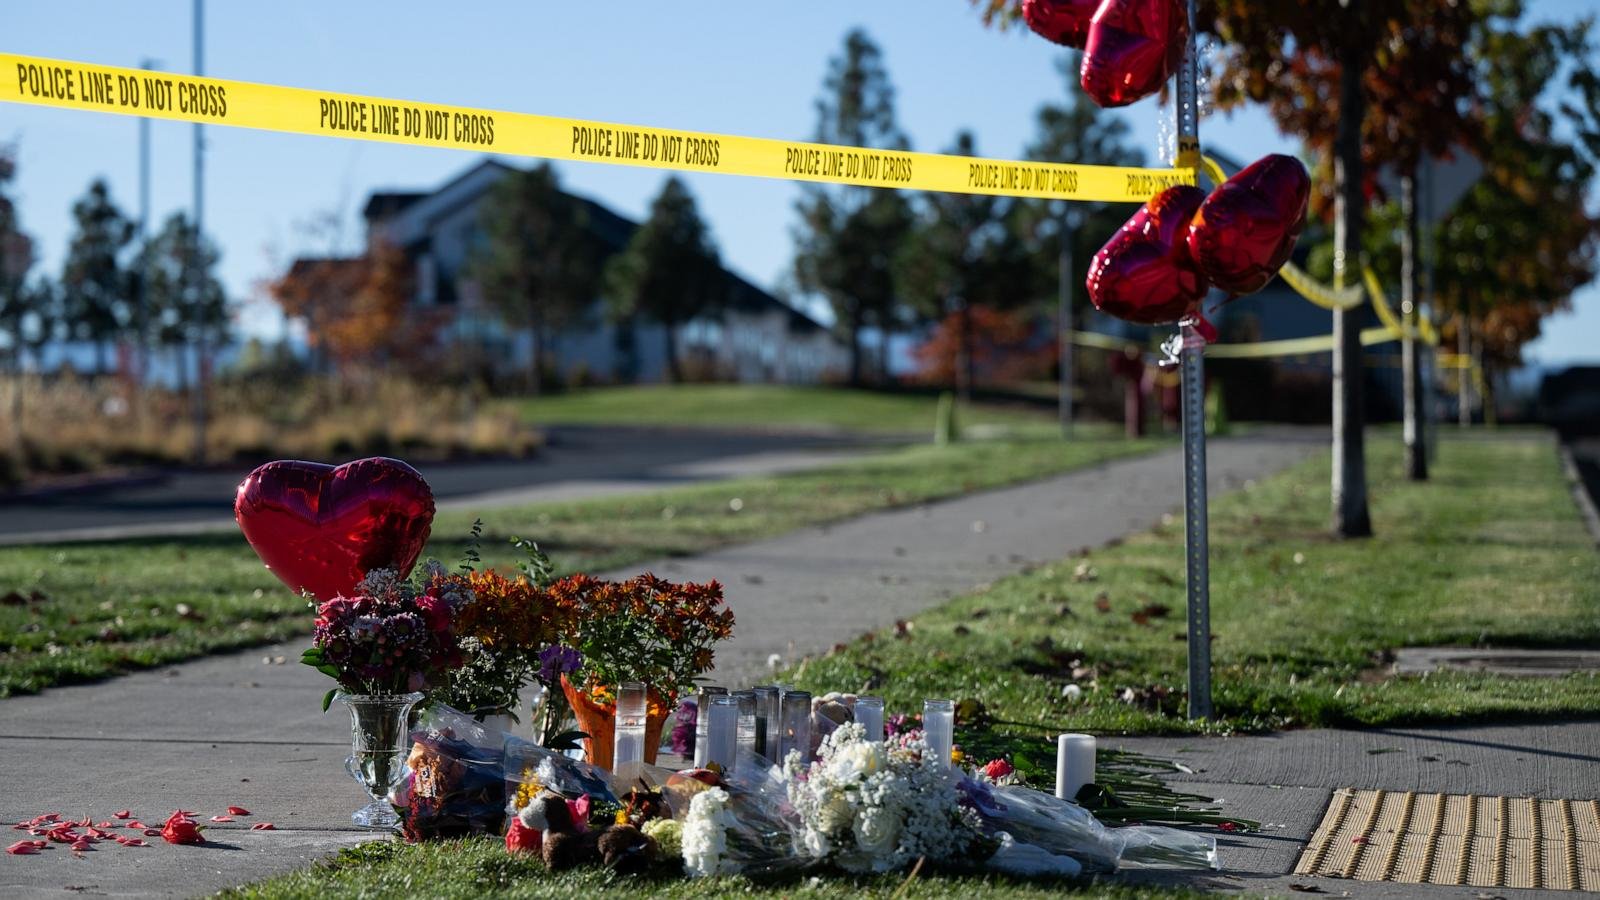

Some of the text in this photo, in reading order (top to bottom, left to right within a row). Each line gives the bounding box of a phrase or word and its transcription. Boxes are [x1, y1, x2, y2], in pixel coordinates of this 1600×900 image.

[17, 64, 227, 117] POLICE LINE DO NOT CROSS
[319, 98, 494, 146] POLICE LINE DO NOT CROSS
[572, 126, 720, 167] POLICE LINE DO NOT CROSS
[785, 148, 913, 183] POLICE LINE DO NOT CROSS
[969, 164, 1078, 193] POLICE LINE DO NOT CROSS
